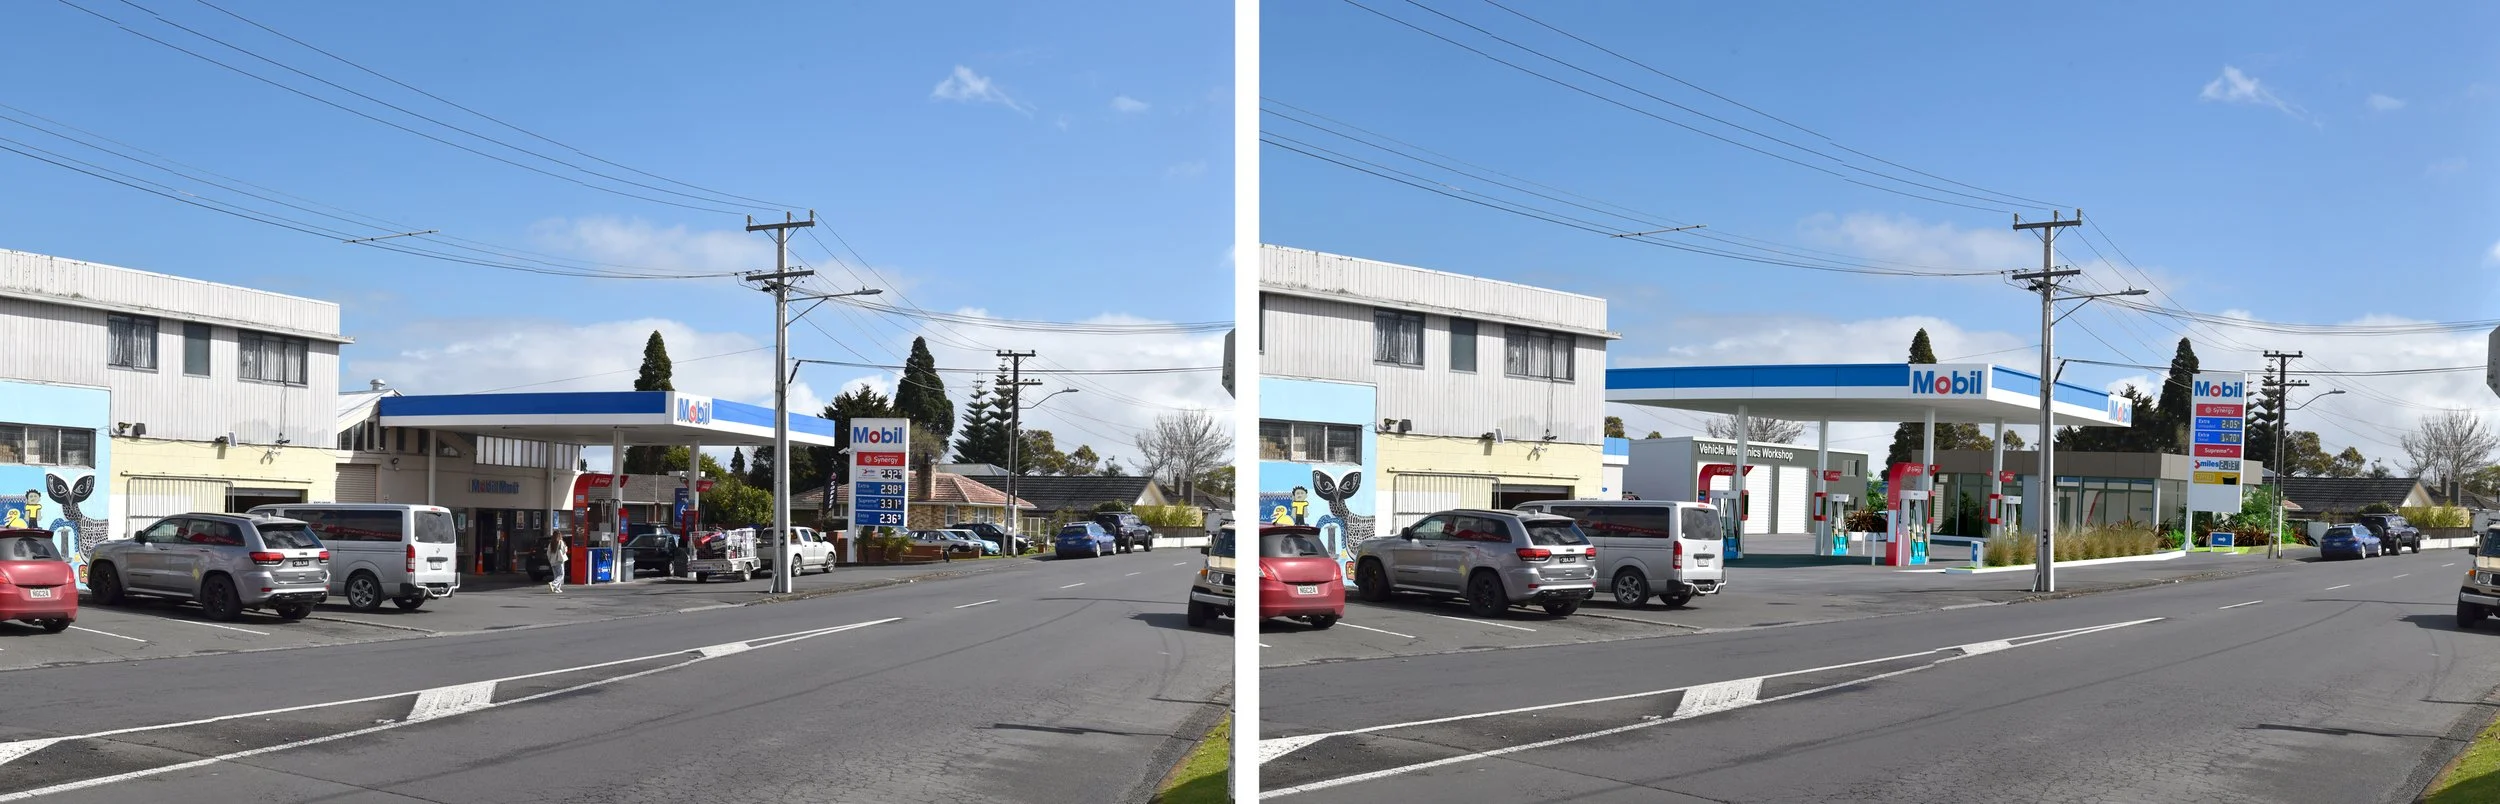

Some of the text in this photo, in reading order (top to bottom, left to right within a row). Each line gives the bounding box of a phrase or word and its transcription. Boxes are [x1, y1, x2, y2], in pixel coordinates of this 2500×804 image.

[1912, 370, 1982, 395] Mobil
[2195, 381, 2243, 398] Mobil
[677, 397, 710, 424] Mobil
[2108, 400, 2131, 424] Mobil
[853, 426, 903, 444] Mobil
[873, 455, 898, 464] Synergy
[1699, 443, 1794, 462] Vehicle Mecnics Workshop
